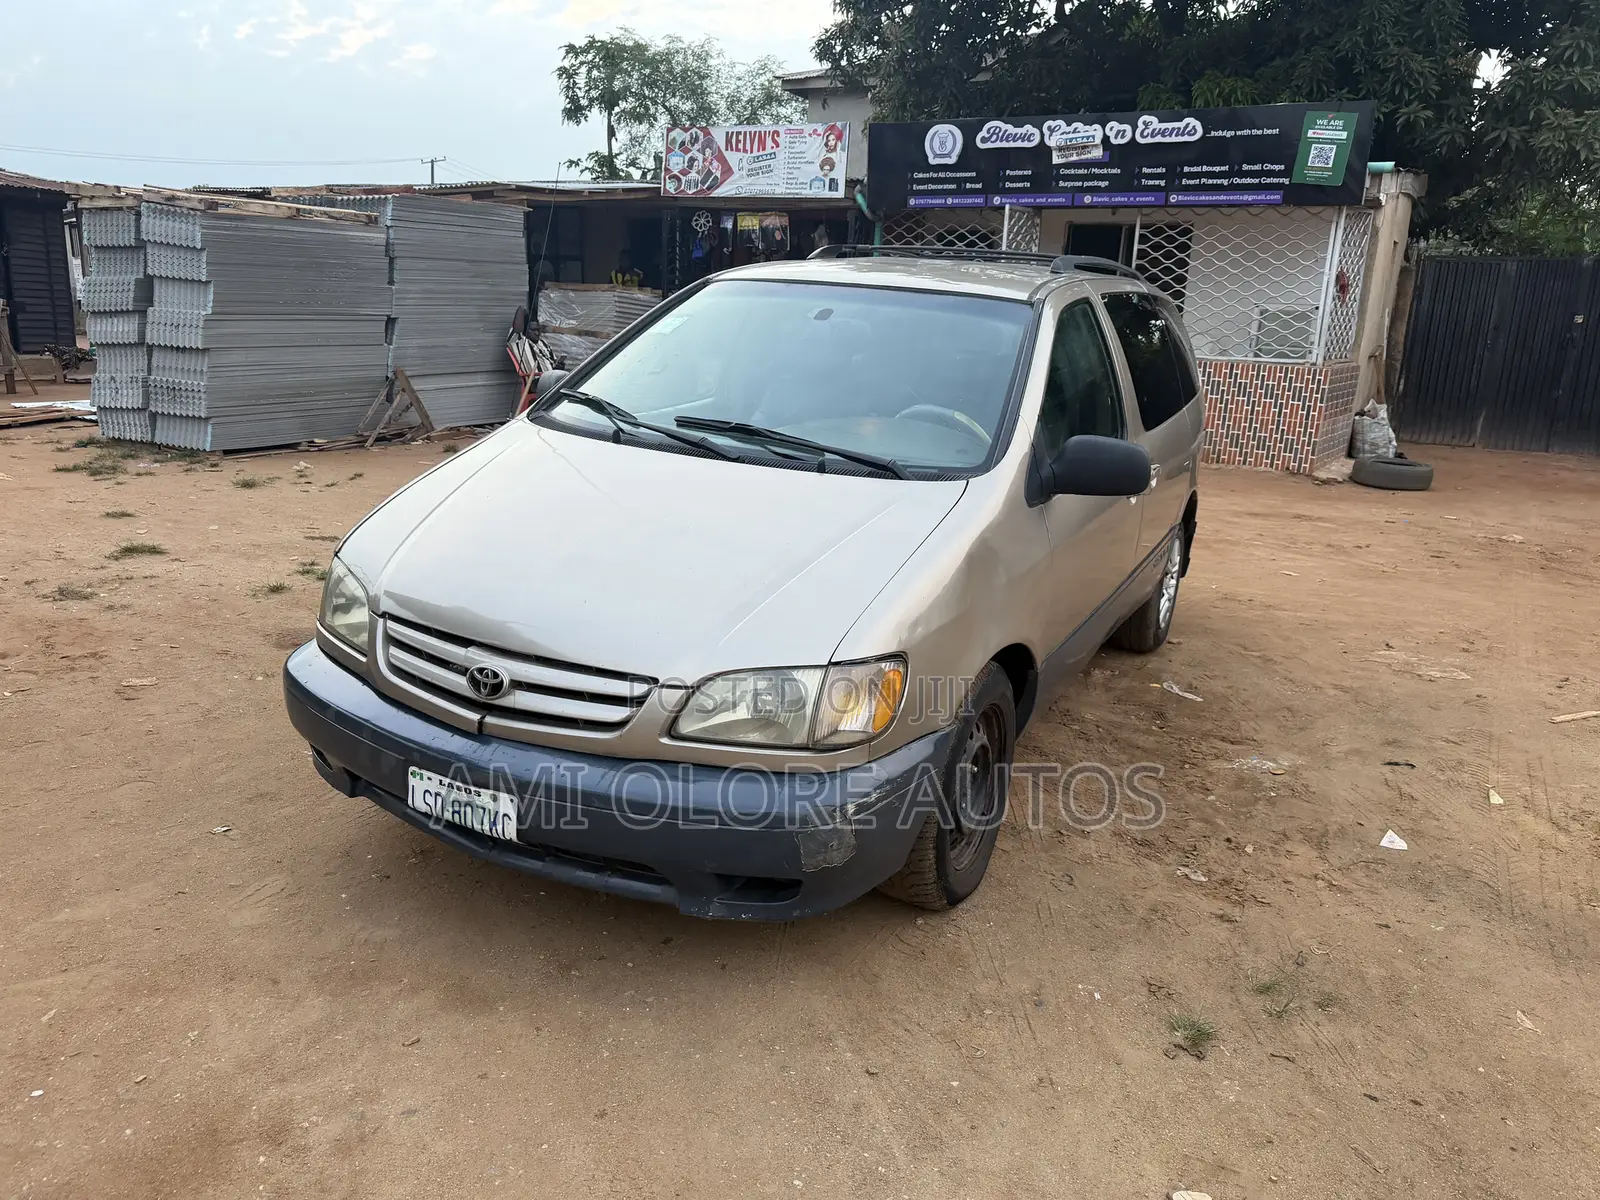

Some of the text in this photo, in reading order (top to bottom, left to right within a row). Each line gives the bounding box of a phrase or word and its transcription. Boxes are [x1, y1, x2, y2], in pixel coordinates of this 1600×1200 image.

[980, 126, 1036, 144] Blevic
[1140, 119, 1198, 139] Events
[725, 129, 780, 154] KELYN'S
[747, 164, 772, 173] REGISTER
[1263, 163, 1285, 171] Chops
[1058, 180, 1109, 188] Surprise package
[1200, 178, 1229, 186] Planning
[438, 779, 482, 797] LAGOS
